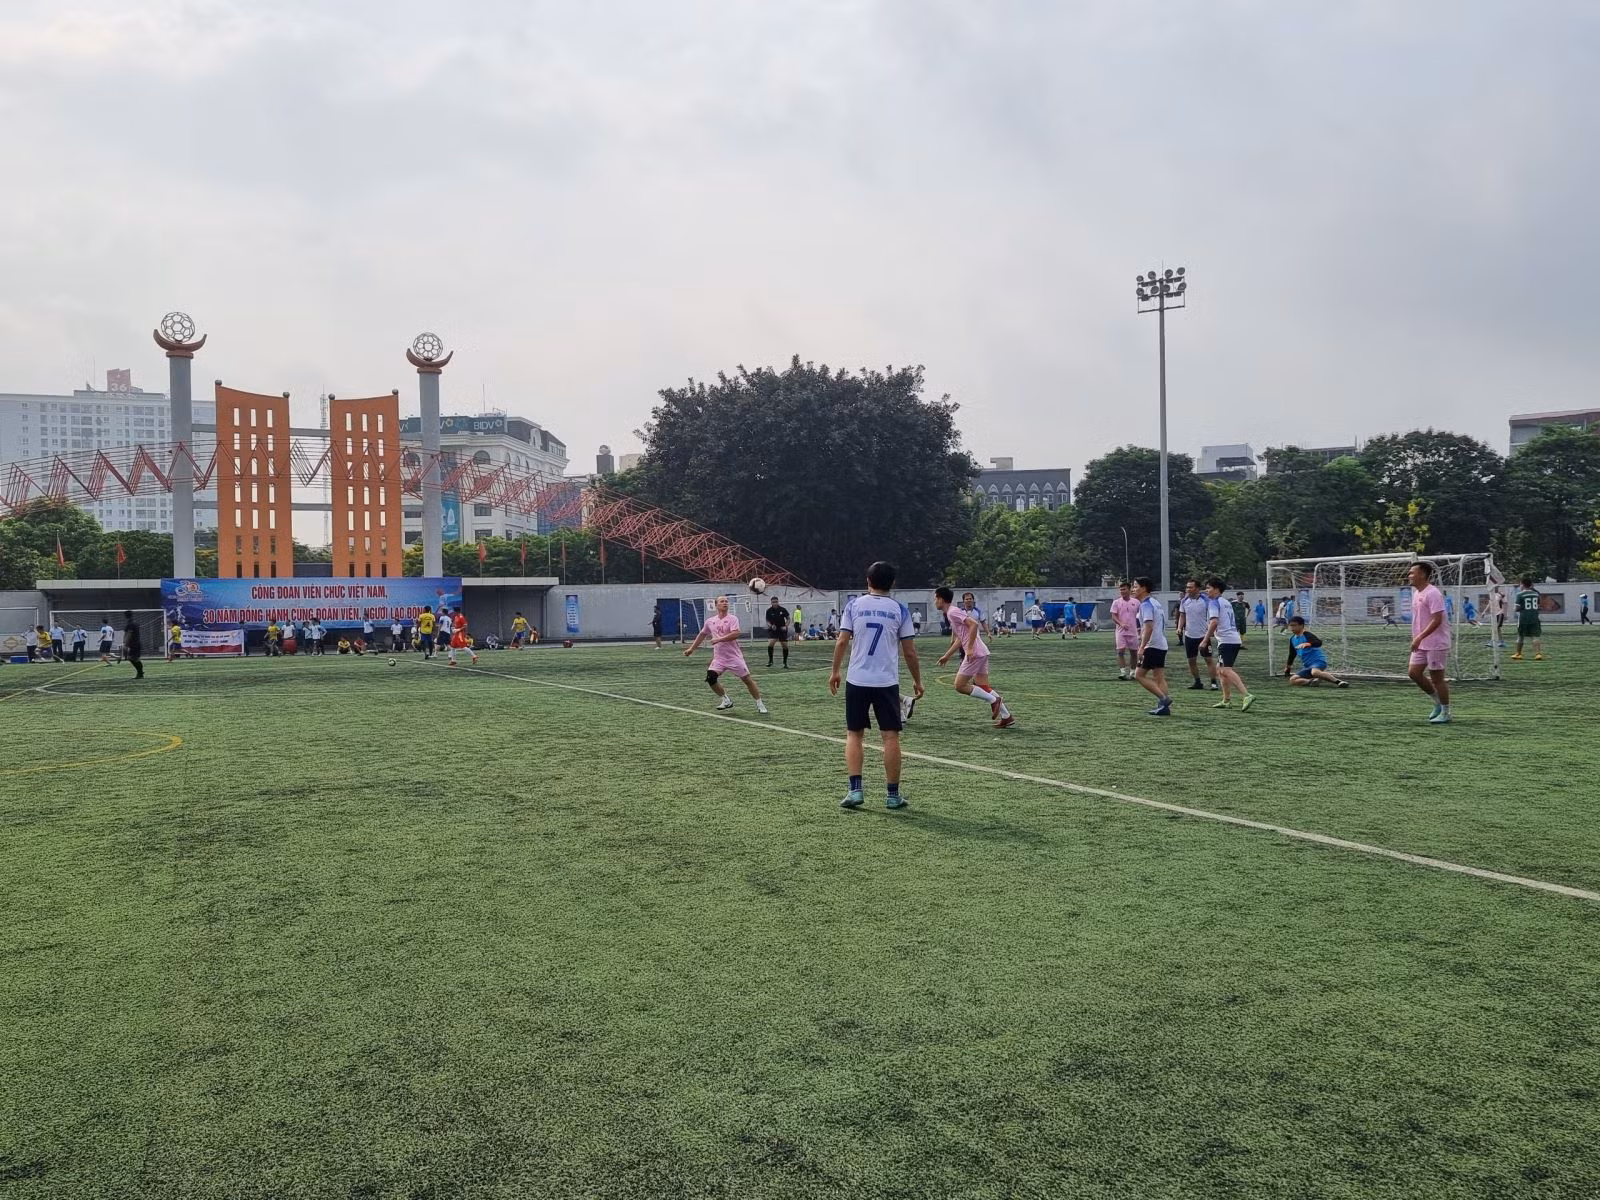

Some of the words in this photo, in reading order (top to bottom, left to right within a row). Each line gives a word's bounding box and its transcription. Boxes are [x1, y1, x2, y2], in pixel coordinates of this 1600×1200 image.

[473, 421, 495, 430] BIDV
[251, 583, 275, 599] CÔNG
[302, 583, 321, 599] VIÊN
[323, 583, 345, 599] CHỨC
[347, 582, 364, 601] VIỆT
[366, 585, 388, 599] NAM,
[203, 609, 215, 623] 30
[866, 622, 884, 656] 7
